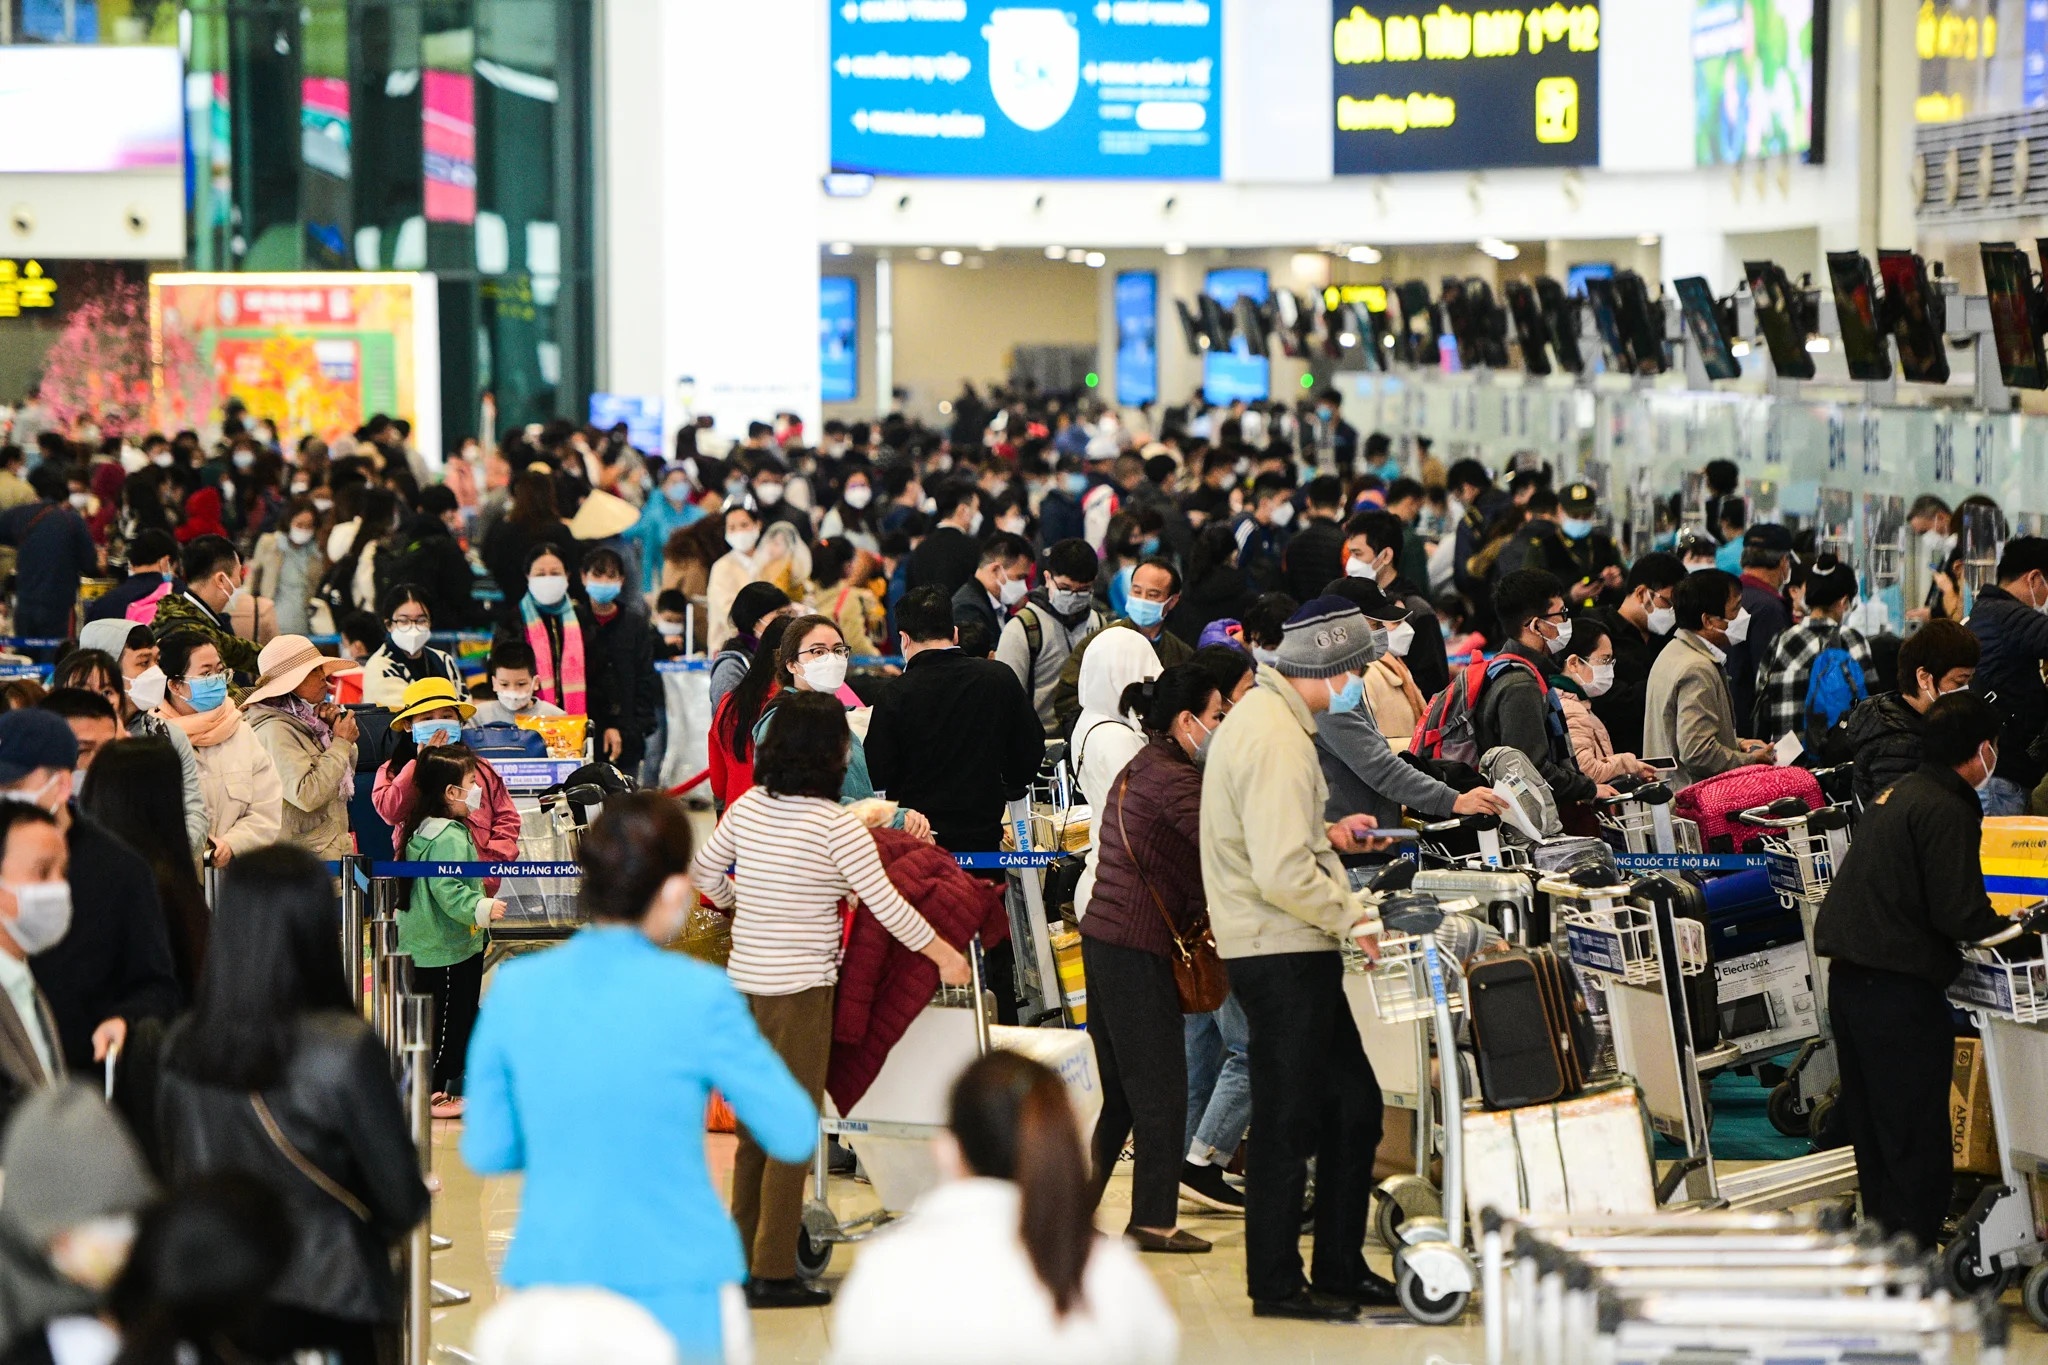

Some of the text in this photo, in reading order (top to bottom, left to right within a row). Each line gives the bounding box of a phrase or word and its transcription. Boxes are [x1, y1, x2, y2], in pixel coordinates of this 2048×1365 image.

[1314, 626, 1348, 649] 68
[954, 856, 973, 865] .I.A
[999, 853, 1029, 865] CẢNG
[1634, 855, 1665, 867] QUỐC
[1667, 854, 1680, 867] TẾ
[1682, 856, 1700, 868] NỘI
[438, 865, 463, 875] N.I.A
[489, 861, 520, 876] CẢNG
[554, 864, 586, 876] KHÔN
[1722, 957, 1771, 977] Electrolux
[1952, 1105, 1967, 1154] APOLO
